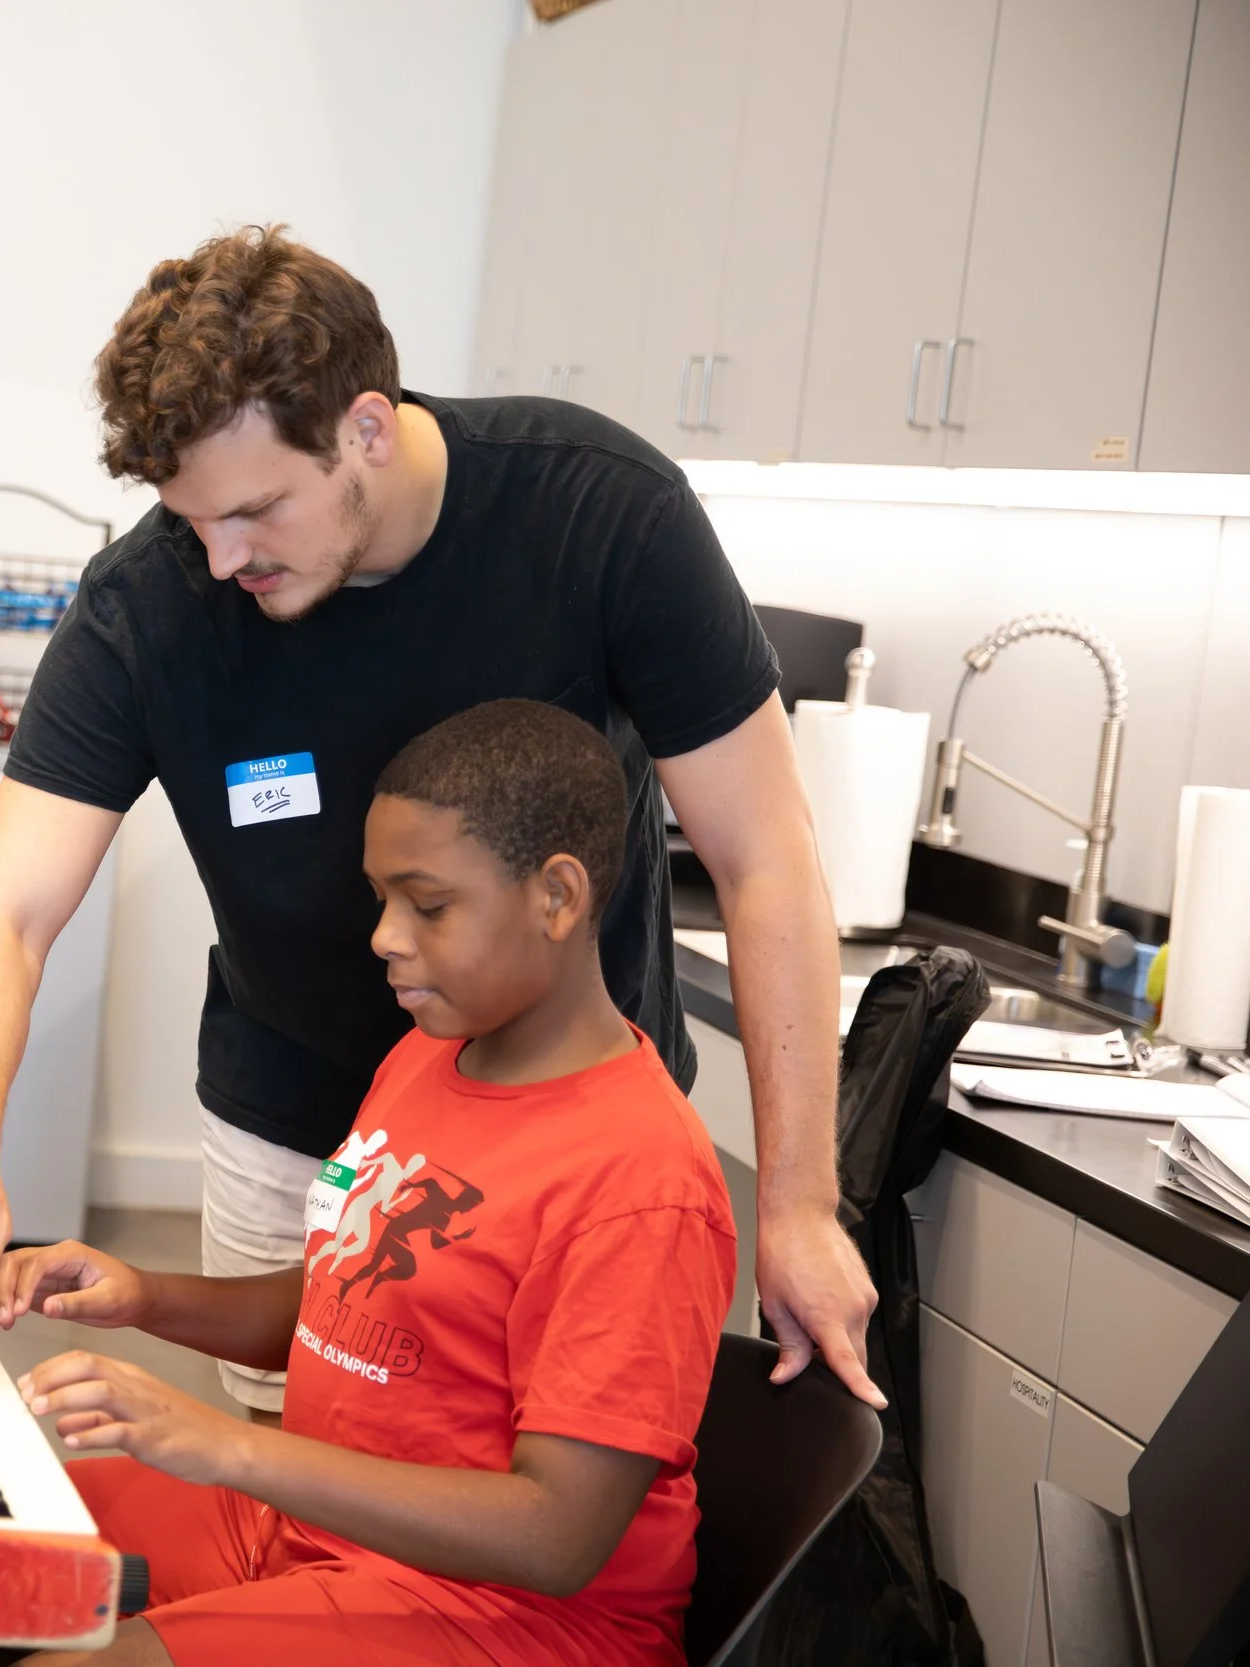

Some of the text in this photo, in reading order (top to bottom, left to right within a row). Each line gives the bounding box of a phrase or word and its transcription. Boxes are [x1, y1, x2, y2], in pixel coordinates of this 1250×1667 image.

[249, 759, 287, 774] HELLO
[252, 786, 291, 808] ERIC
[311, 1294, 425, 1378] CLUB
[297, 1322, 389, 1385] SPECIAL OLYMPICS
[1012, 1377, 1050, 1411] HOSPITALITY
